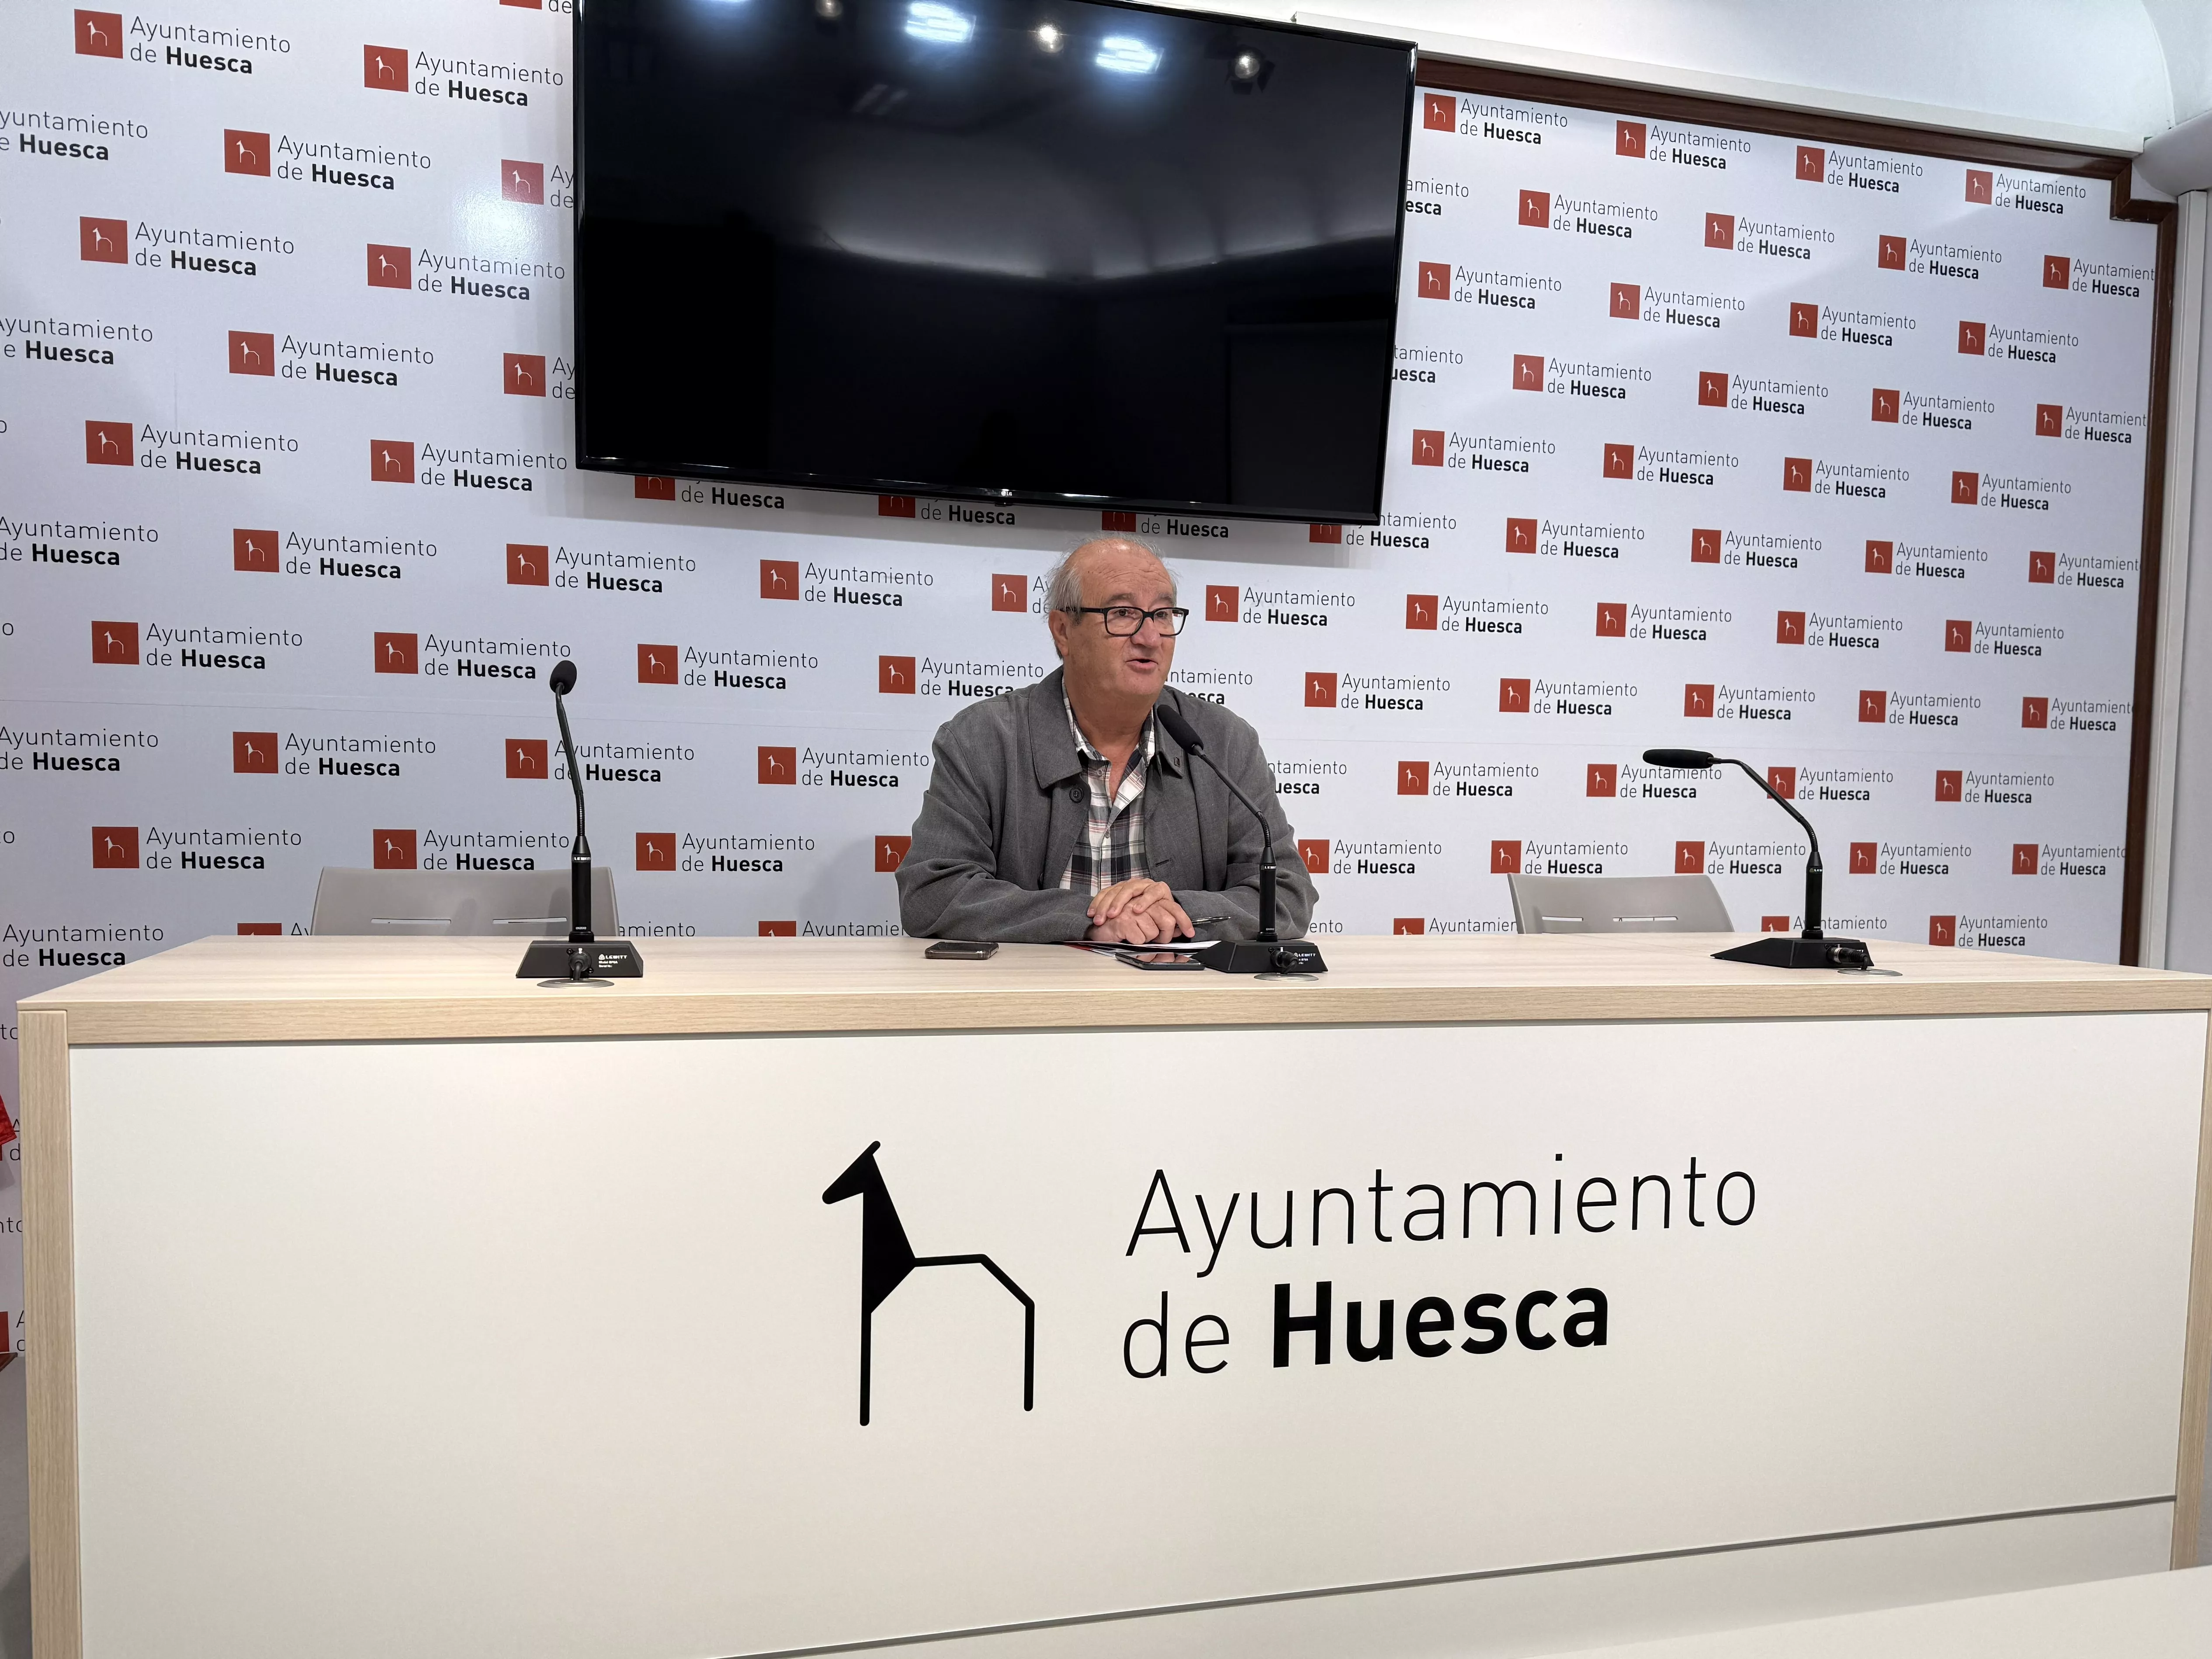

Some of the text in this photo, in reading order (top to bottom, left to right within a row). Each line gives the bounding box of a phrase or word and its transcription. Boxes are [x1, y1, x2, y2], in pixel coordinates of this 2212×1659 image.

[130, 16, 290, 53] Ayuntamiento
[130, 42, 252, 74] de Huesca
[415, 51, 563, 86] Ayuntamiento
[415, 76, 528, 107] de Huesca
[1460, 98, 1567, 127] Ayuntamiento
[1460, 119, 1541, 145] de Huesca
[1650, 125, 1751, 153] Ayuntamiento
[277, 135, 430, 169] Ayuntamiento
[1650, 146, 1726, 170] de Huesca
[1828, 150, 1923, 177] Ayuntamiento
[277, 160, 394, 190] de Huesca
[1827, 170, 1899, 193] de Huesca
[1996, 173, 2086, 198] Ayuntamiento
[1554, 194, 1657, 221] Ayuntamiento
[1995, 192, 2063, 215] de Huesca
[135, 222, 294, 254] Ayuntamiento
[1553, 215, 1632, 239] de Huesca
[1738, 217, 1834, 243] Ayuntamiento
[1737, 237, 1810, 260] de Huesca
[135, 247, 256, 276] de Huesca
[418, 249, 565, 279] Ayuntamiento
[418, 273, 530, 300] de Huesca
[1455, 265, 1561, 292] Ayuntamiento
[1454, 286, 1535, 309] de Huesca
[1822, 305, 1916, 330] Ayuntamiento
[1821, 325, 1893, 347] de Huesca
[1989, 324, 2078, 347] Ayuntamiento
[281, 335, 433, 364] Ayuntamiento
[1988, 343, 2056, 363] de Huesca
[281, 360, 397, 386] de Huesca
[1548, 357, 1651, 381] Ayuntamiento
[1548, 378, 1626, 399] de Huesca
[140, 423, 298, 452] Ayuntamiento
[1449, 431, 1555, 454] Ayuntamiento
[141, 449, 261, 475] de Huesca
[421, 443, 567, 470] Ayuntamiento
[1448, 452, 1529, 473] de Huesca
[1638, 446, 1738, 468] Ayuntamiento
[421, 467, 532, 491] de Huesca
[1637, 465, 1713, 486] de Huesca
[1982, 473, 2071, 494] Ayuntamiento
[681, 485, 784, 509] de Huesca
[1981, 492, 2049, 510] de Huesca
[1141, 520, 1228, 538] de Huesca
[1346, 530, 1429, 549] de Huesca
[286, 531, 437, 557] Ayuntamiento
[1725, 530, 1822, 551] Ayuntamiento
[286, 556, 401, 579] de Huesca
[555, 546, 696, 572] Ayuntamiento
[1724, 550, 1798, 569] de Huesca
[555, 570, 662, 593] de Huesca
[805, 562, 933, 586] Ayuntamiento
[805, 585, 902, 607] de Huesca
[1244, 587, 1355, 607] Ayuntamiento
[1442, 595, 1548, 615] Ayuntamiento
[1243, 607, 1327, 626] de Huesca
[1442, 616, 1522, 634] de Huesca
[1809, 612, 1903, 631] Ayuntamiento
[146, 623, 302, 647] Ayuntamiento
[425, 634, 570, 657] Ayuntamiento
[1808, 631, 1879, 649] de Huesca
[146, 648, 265, 670] de Huesca
[684, 646, 818, 668] Ayuntamiento
[921, 657, 1044, 678] Ayuntamiento
[425, 658, 536, 679] de Huesca
[684, 669, 786, 690] de Huesca
[921, 679, 941, 695] de
[1342, 673, 1450, 693] Ayuntamiento
[1341, 693, 1423, 710] de Huesca
[285, 732, 436, 756] Ayuntamiento
[285, 757, 400, 776] de Huesca
[802, 747, 929, 768] Ayuntamiento
[802, 769, 898, 788] de Huesca
[1434, 761, 1539, 780] Ayuntamiento
[1799, 767, 1893, 785] Ayuntamiento
[1433, 781, 1512, 797] de Huesca
[1799, 785, 1870, 801] de Huesca
[146, 826, 301, 850] Ayuntamiento
[423, 829, 569, 852] Ayuntamiento
[682, 833, 815, 854] Ayuntamiento
[1334, 839, 1442, 858] Ayuntamiento
[146, 851, 264, 869] de Huesca
[1526, 840, 1628, 859] Ayuntamiento
[1709, 841, 1806, 859] Ayuntamiento
[1881, 842, 1971, 860] Ayuntamiento
[423, 853, 534, 871] de Huesca
[682, 855, 783, 872] de Huesca
[1334, 859, 1415, 874] de Huesca
[1525, 859, 1602, 874] de Huesca
[1708, 860, 1782, 874] de Huesca
[1880, 861, 1949, 875] de Huesca
[2, 923, 163, 947] Ayuntamiento
[1959, 915, 2047, 933] Ayuntamiento
[1959, 933, 2025, 947] de Huesca
[3, 948, 126, 967] de Huesca
[1125, 1153, 1755, 1278] Ayuntamiento
[1123, 1281, 1608, 1378] de Huesca
